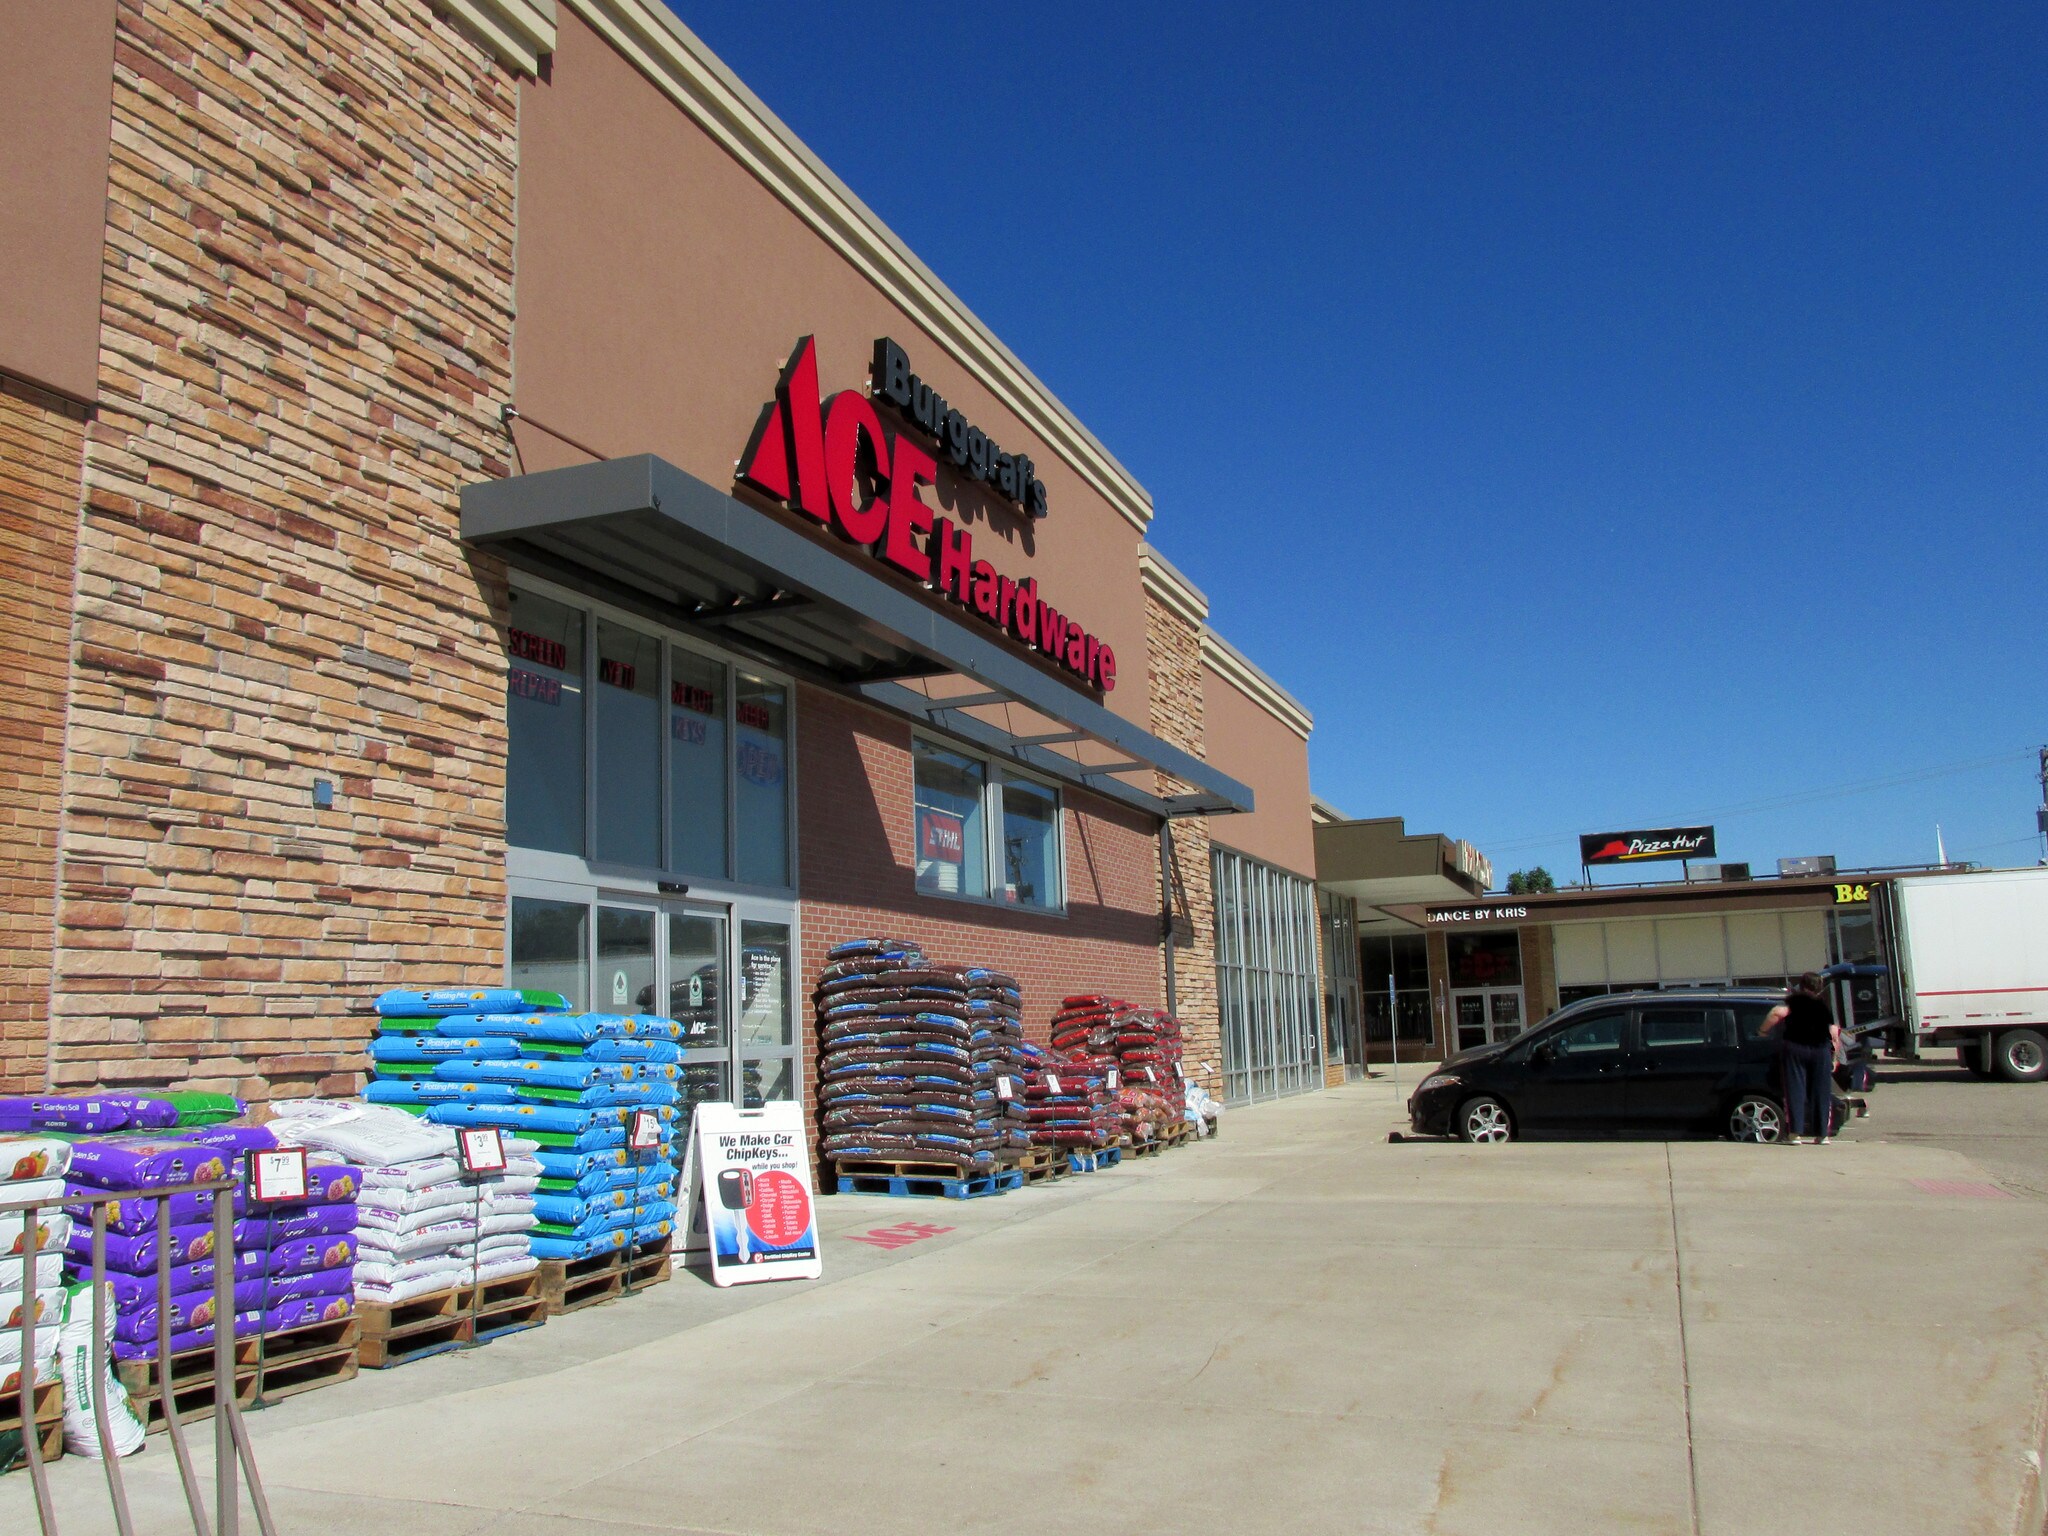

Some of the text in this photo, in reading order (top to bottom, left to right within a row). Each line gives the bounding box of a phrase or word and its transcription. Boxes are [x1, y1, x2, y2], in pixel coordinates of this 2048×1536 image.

[874, 337, 1048, 519] Burggraf's
[737, 334, 1117, 692] ACE Hardware
[509, 627, 565, 670] SCREEN
[510, 667, 560, 707] REPAIR
[928, 824, 962, 851] STIHL
[1628, 834, 1708, 855] Pizza Hut
[1834, 882, 1880, 903] B&
[1427, 906, 1527, 923] DANCE BY KRIS
[432, 992, 456, 1000] Potting
[487, 1014, 510, 1023] Potting
[690, 1020, 707, 1034] ACE
[427, 1039, 450, 1047] Potting
[484, 1060, 509, 1068] Potting
[424, 1082, 447, 1091] Potting
[43, 1102, 80, 1111] Garden Soil
[479, 1104, 503, 1113] Potting
[719, 1133, 793, 1147] We Make Car
[726, 1147, 788, 1162] ChipKeys...
[752, 1161, 798, 1170] while you shop!
